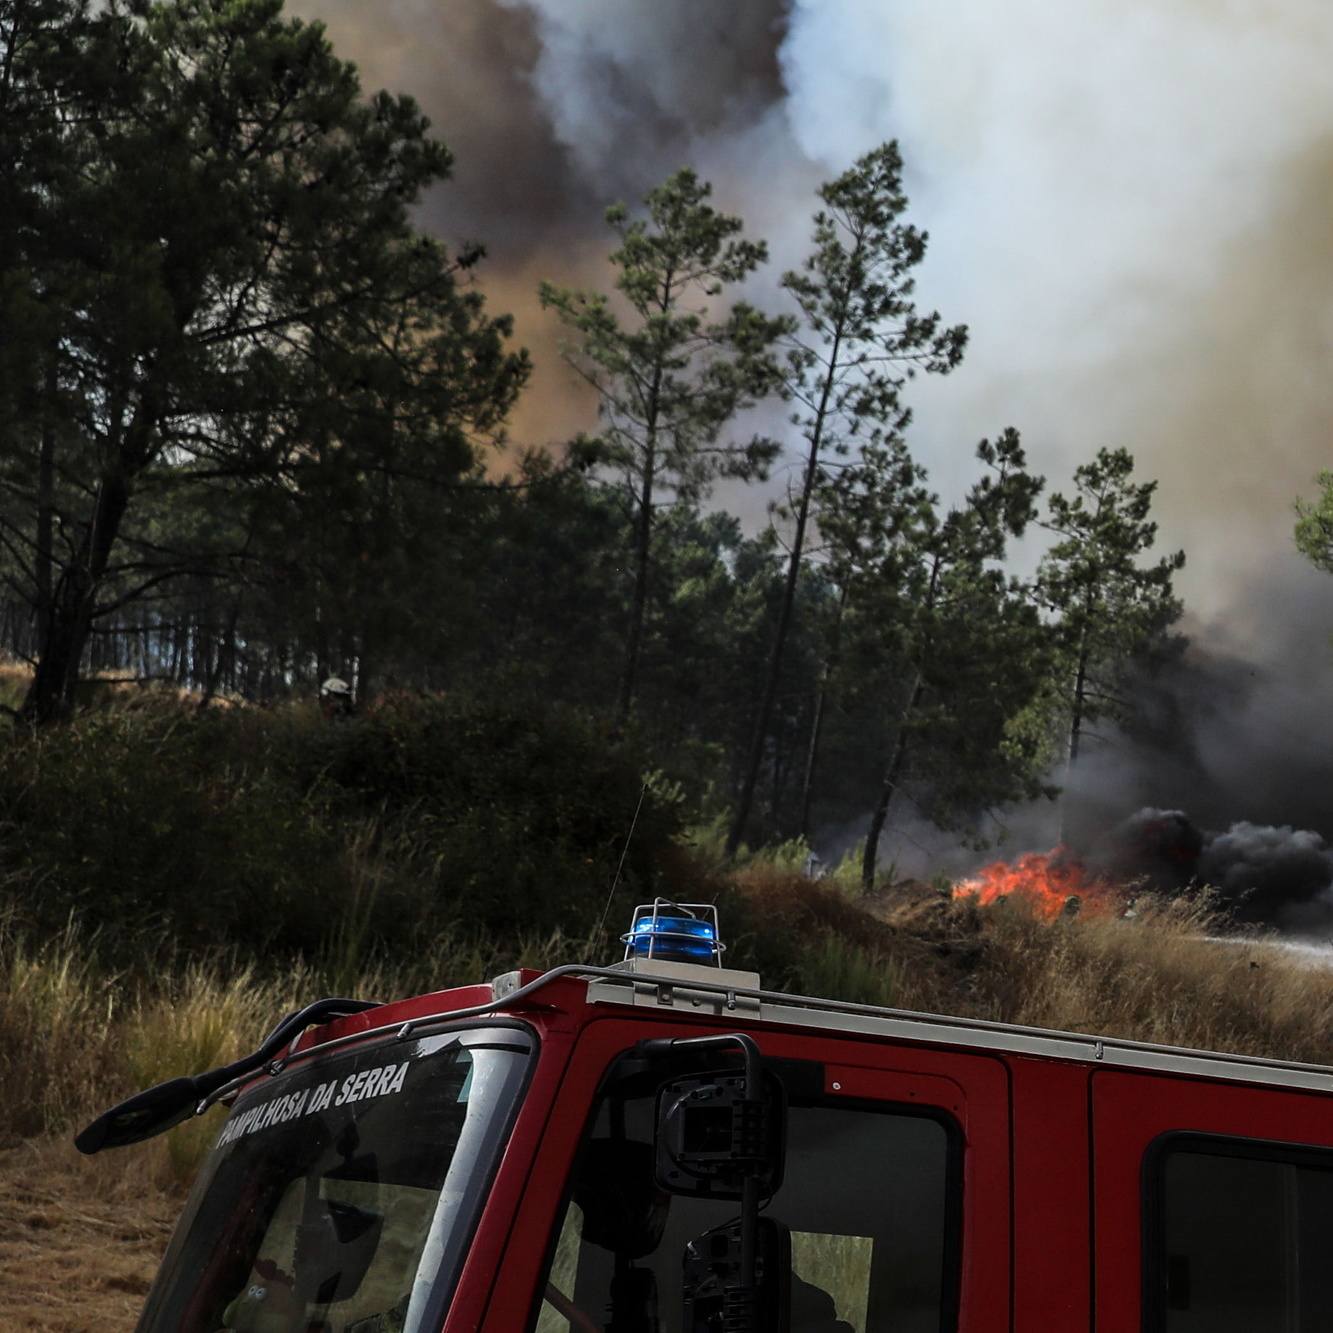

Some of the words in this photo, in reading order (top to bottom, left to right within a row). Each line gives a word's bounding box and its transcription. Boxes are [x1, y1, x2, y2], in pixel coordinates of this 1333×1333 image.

[215, 1088, 310, 1150] PAMPILHOSA
[306, 1080, 338, 1115] DA
[335, 1062, 410, 1107] SERRA
